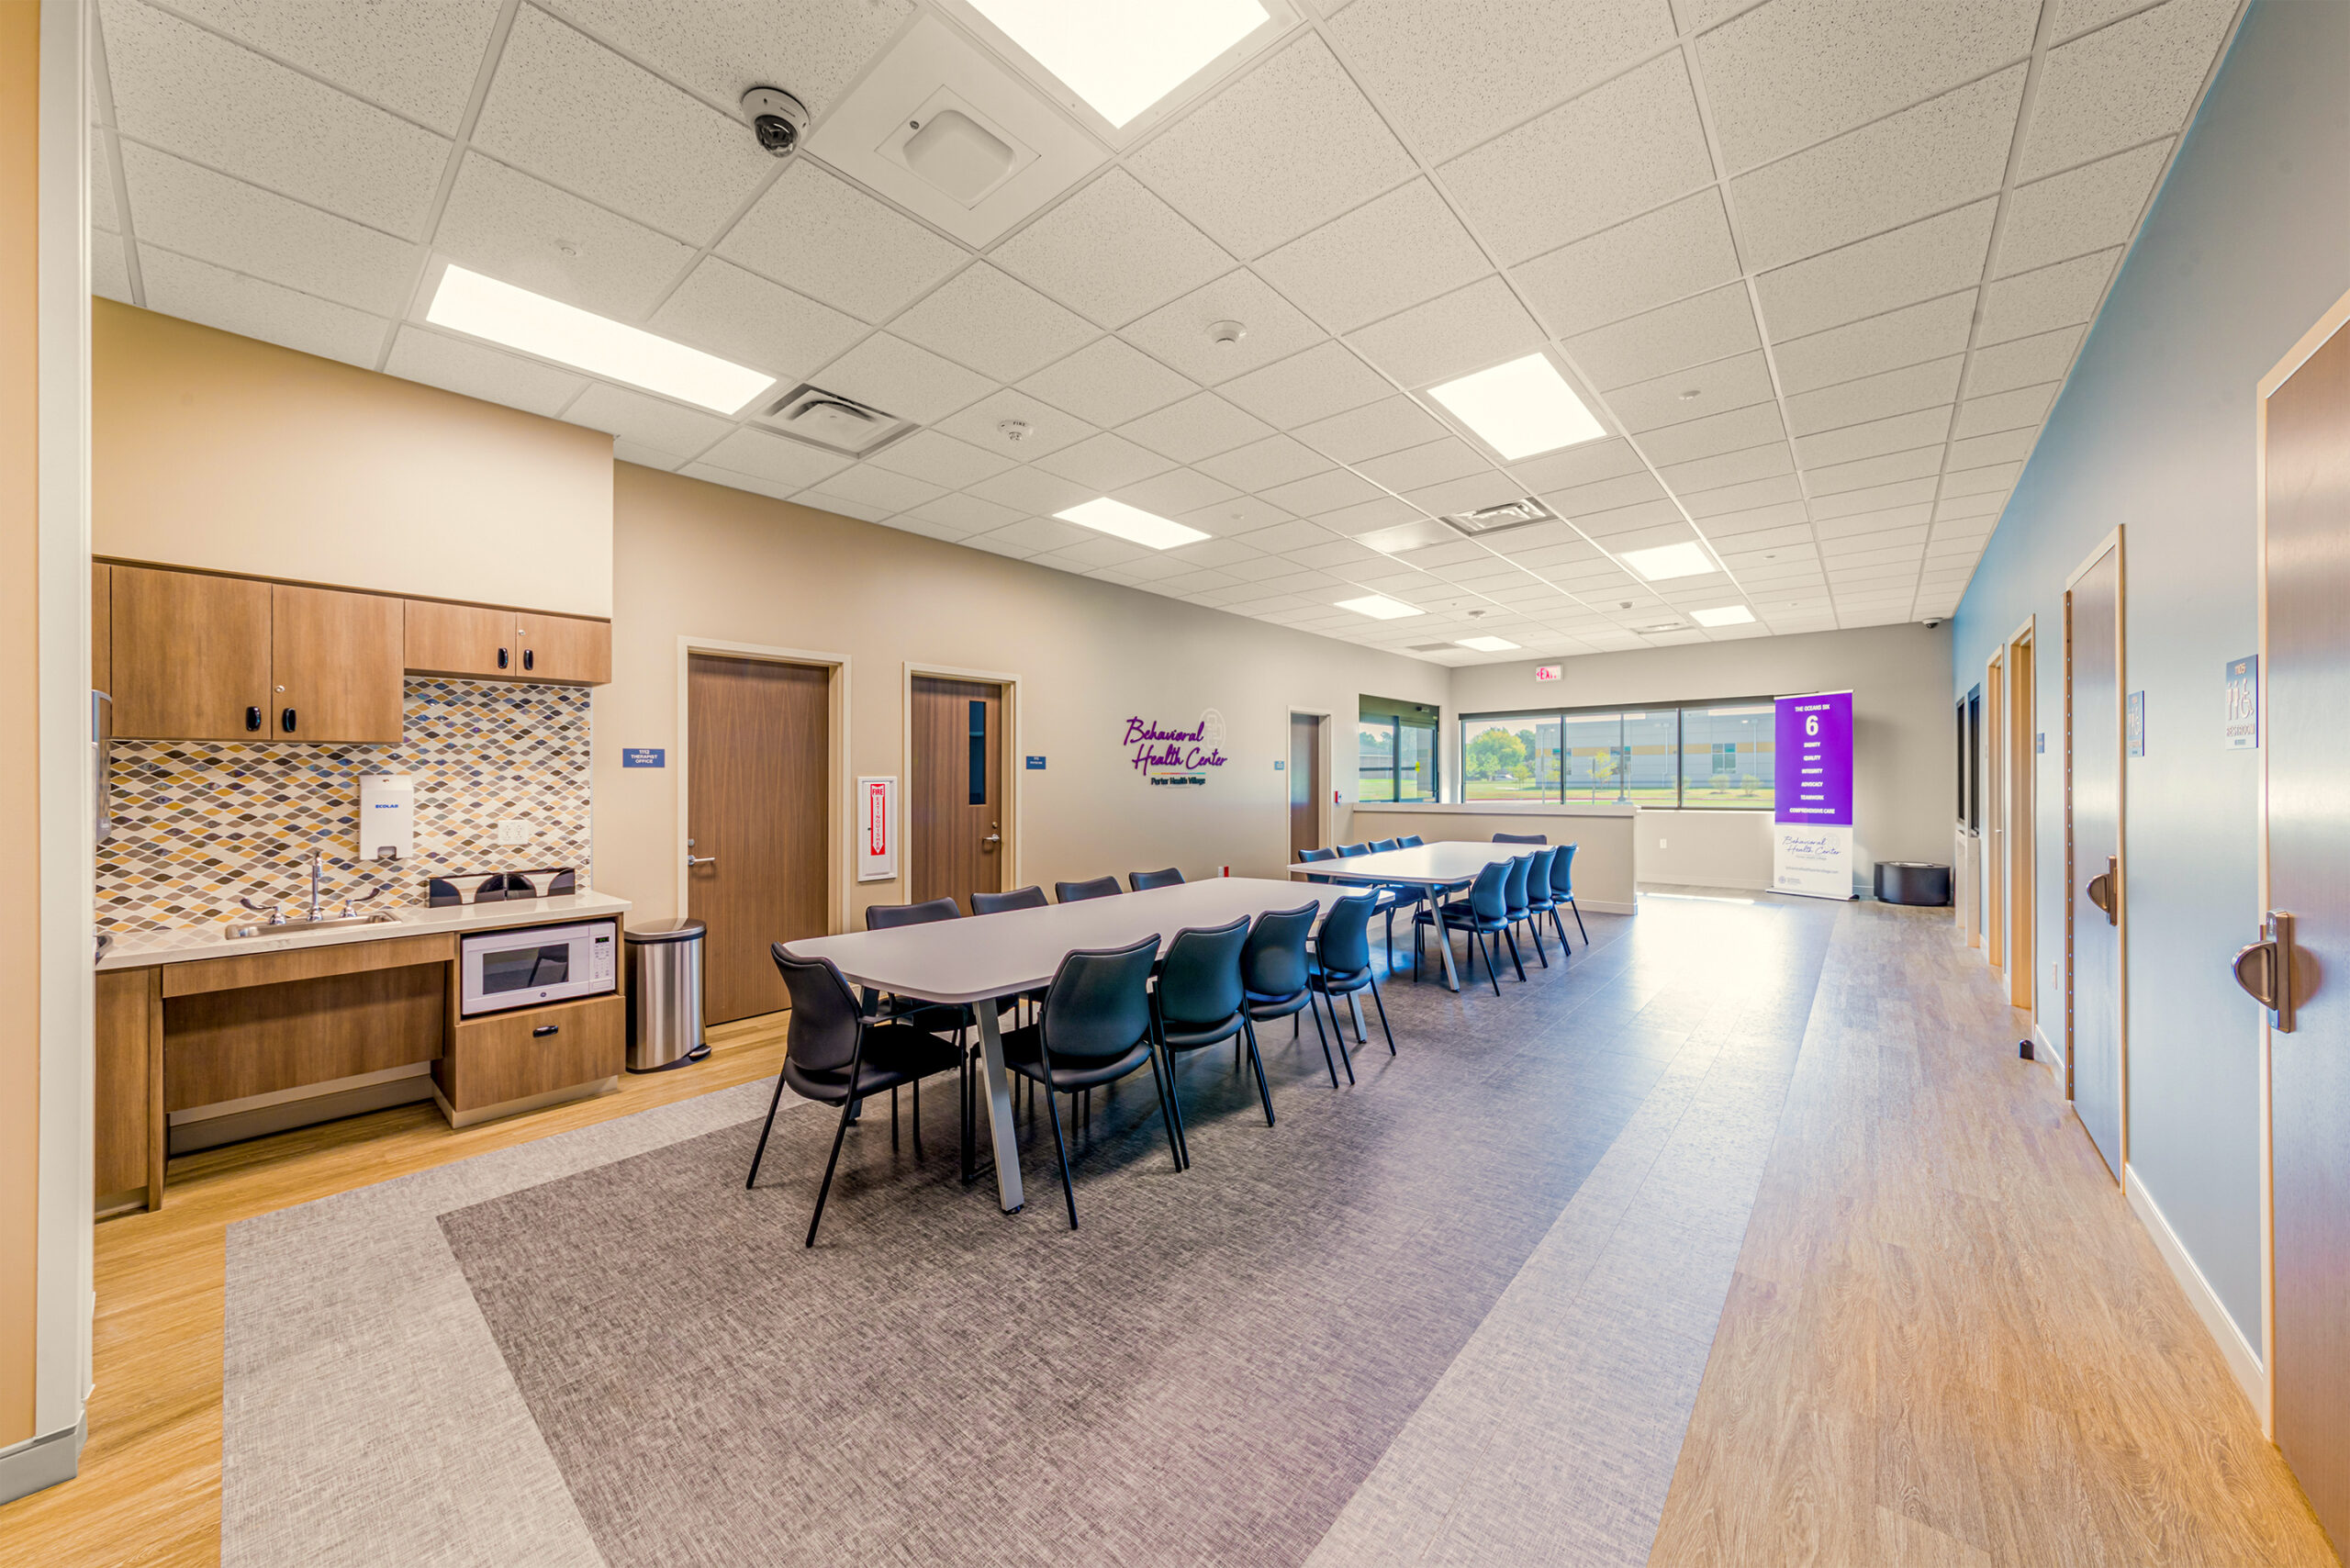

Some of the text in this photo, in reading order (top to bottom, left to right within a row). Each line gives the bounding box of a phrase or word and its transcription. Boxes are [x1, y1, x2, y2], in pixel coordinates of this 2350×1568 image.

[1124, 716, 1204, 745] Behavioral
[1806, 714, 1818, 736] 6
[2226, 723, 2255, 737] RESTROOM
[1132, 744, 1227, 776] Health Center
[1188, 777, 1206, 786] Village
[1782, 835, 1826, 845] Behavioral
[1785, 845, 1841, 855] Health Center
